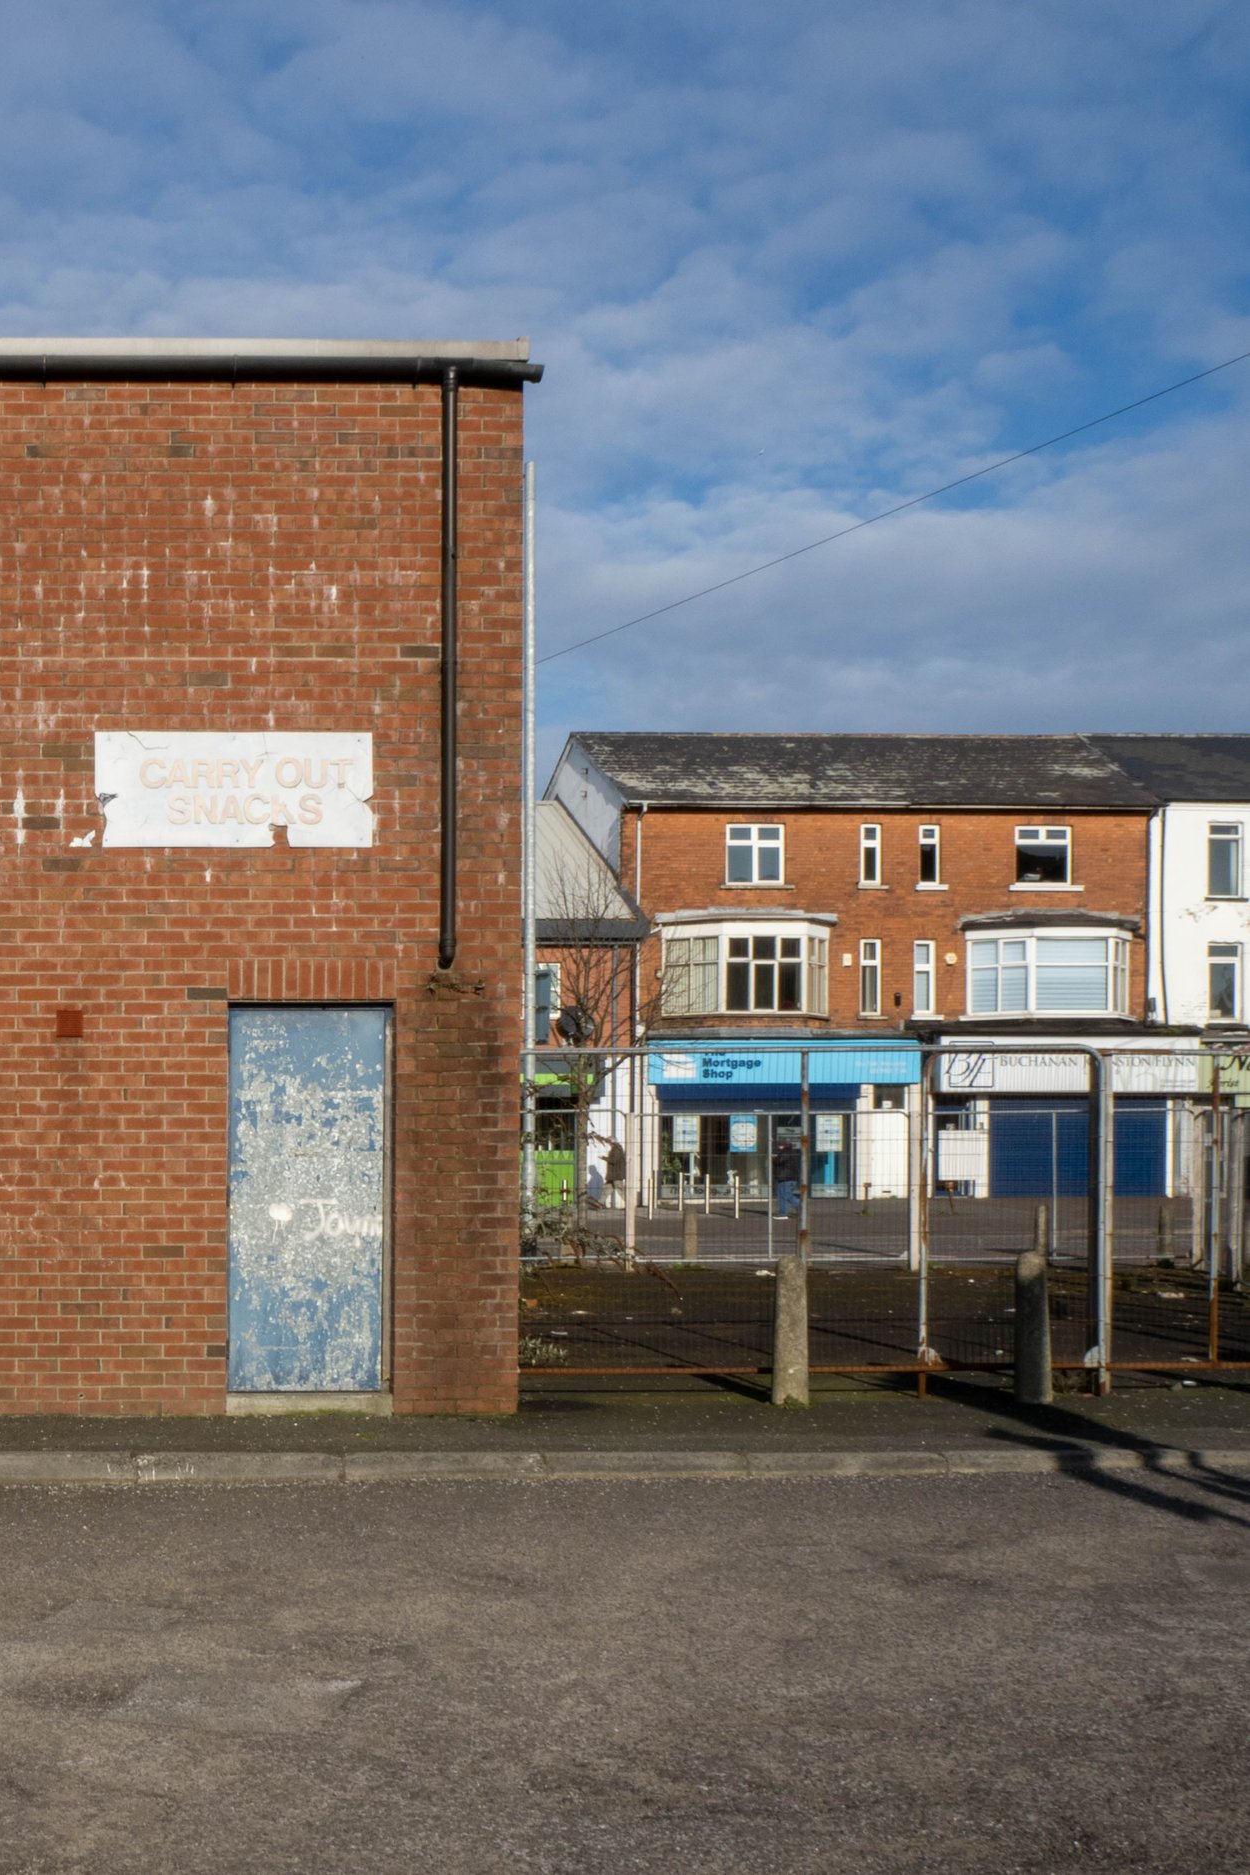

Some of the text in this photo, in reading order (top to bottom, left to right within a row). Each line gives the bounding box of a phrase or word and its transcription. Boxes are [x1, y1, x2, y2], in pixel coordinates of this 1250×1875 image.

[139, 757, 354, 789] CARRY OUT
[167, 794, 324, 825] SNACKS
[702, 1058, 762, 1070] Mortgage
[702, 1068, 734, 1080] Shop
